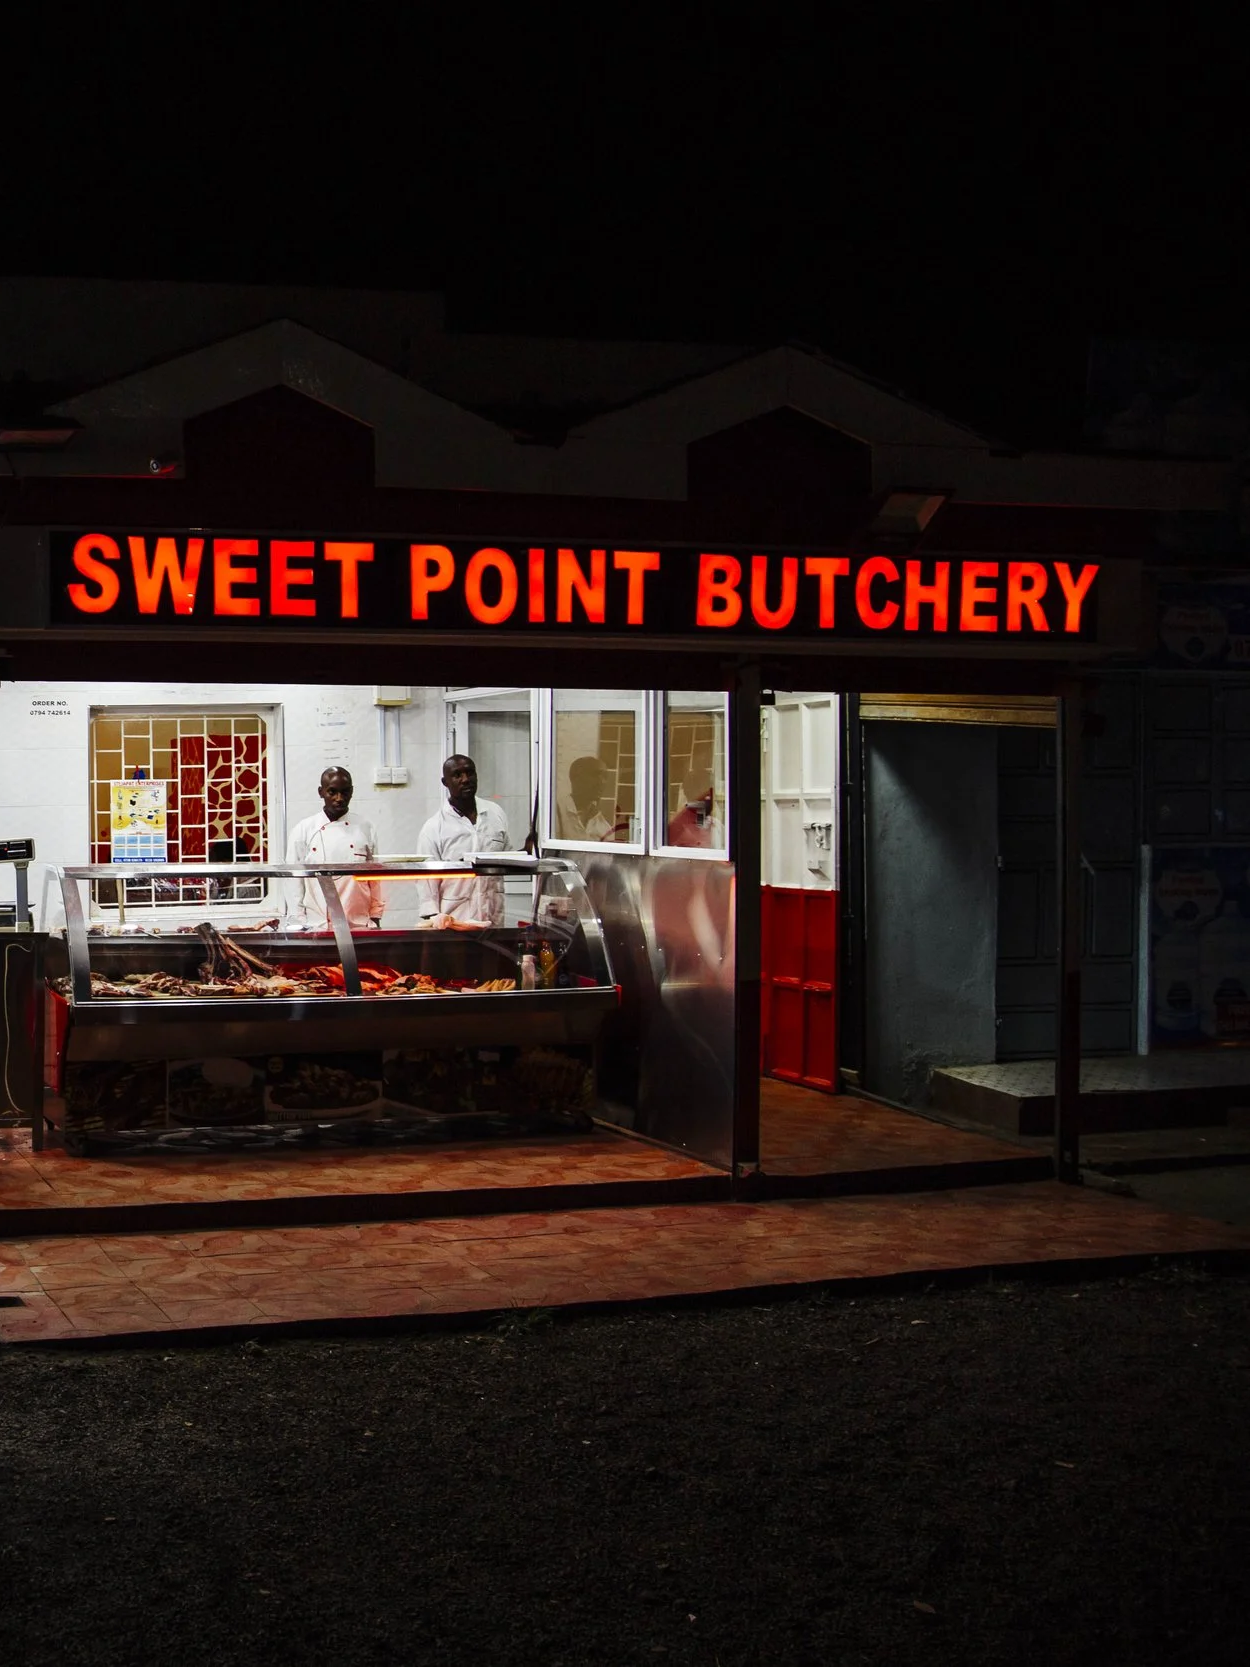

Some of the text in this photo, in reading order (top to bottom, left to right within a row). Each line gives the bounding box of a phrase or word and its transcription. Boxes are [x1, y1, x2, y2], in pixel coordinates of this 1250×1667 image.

[67, 532, 1101, 633] SWEET POINT BUTCHERY
